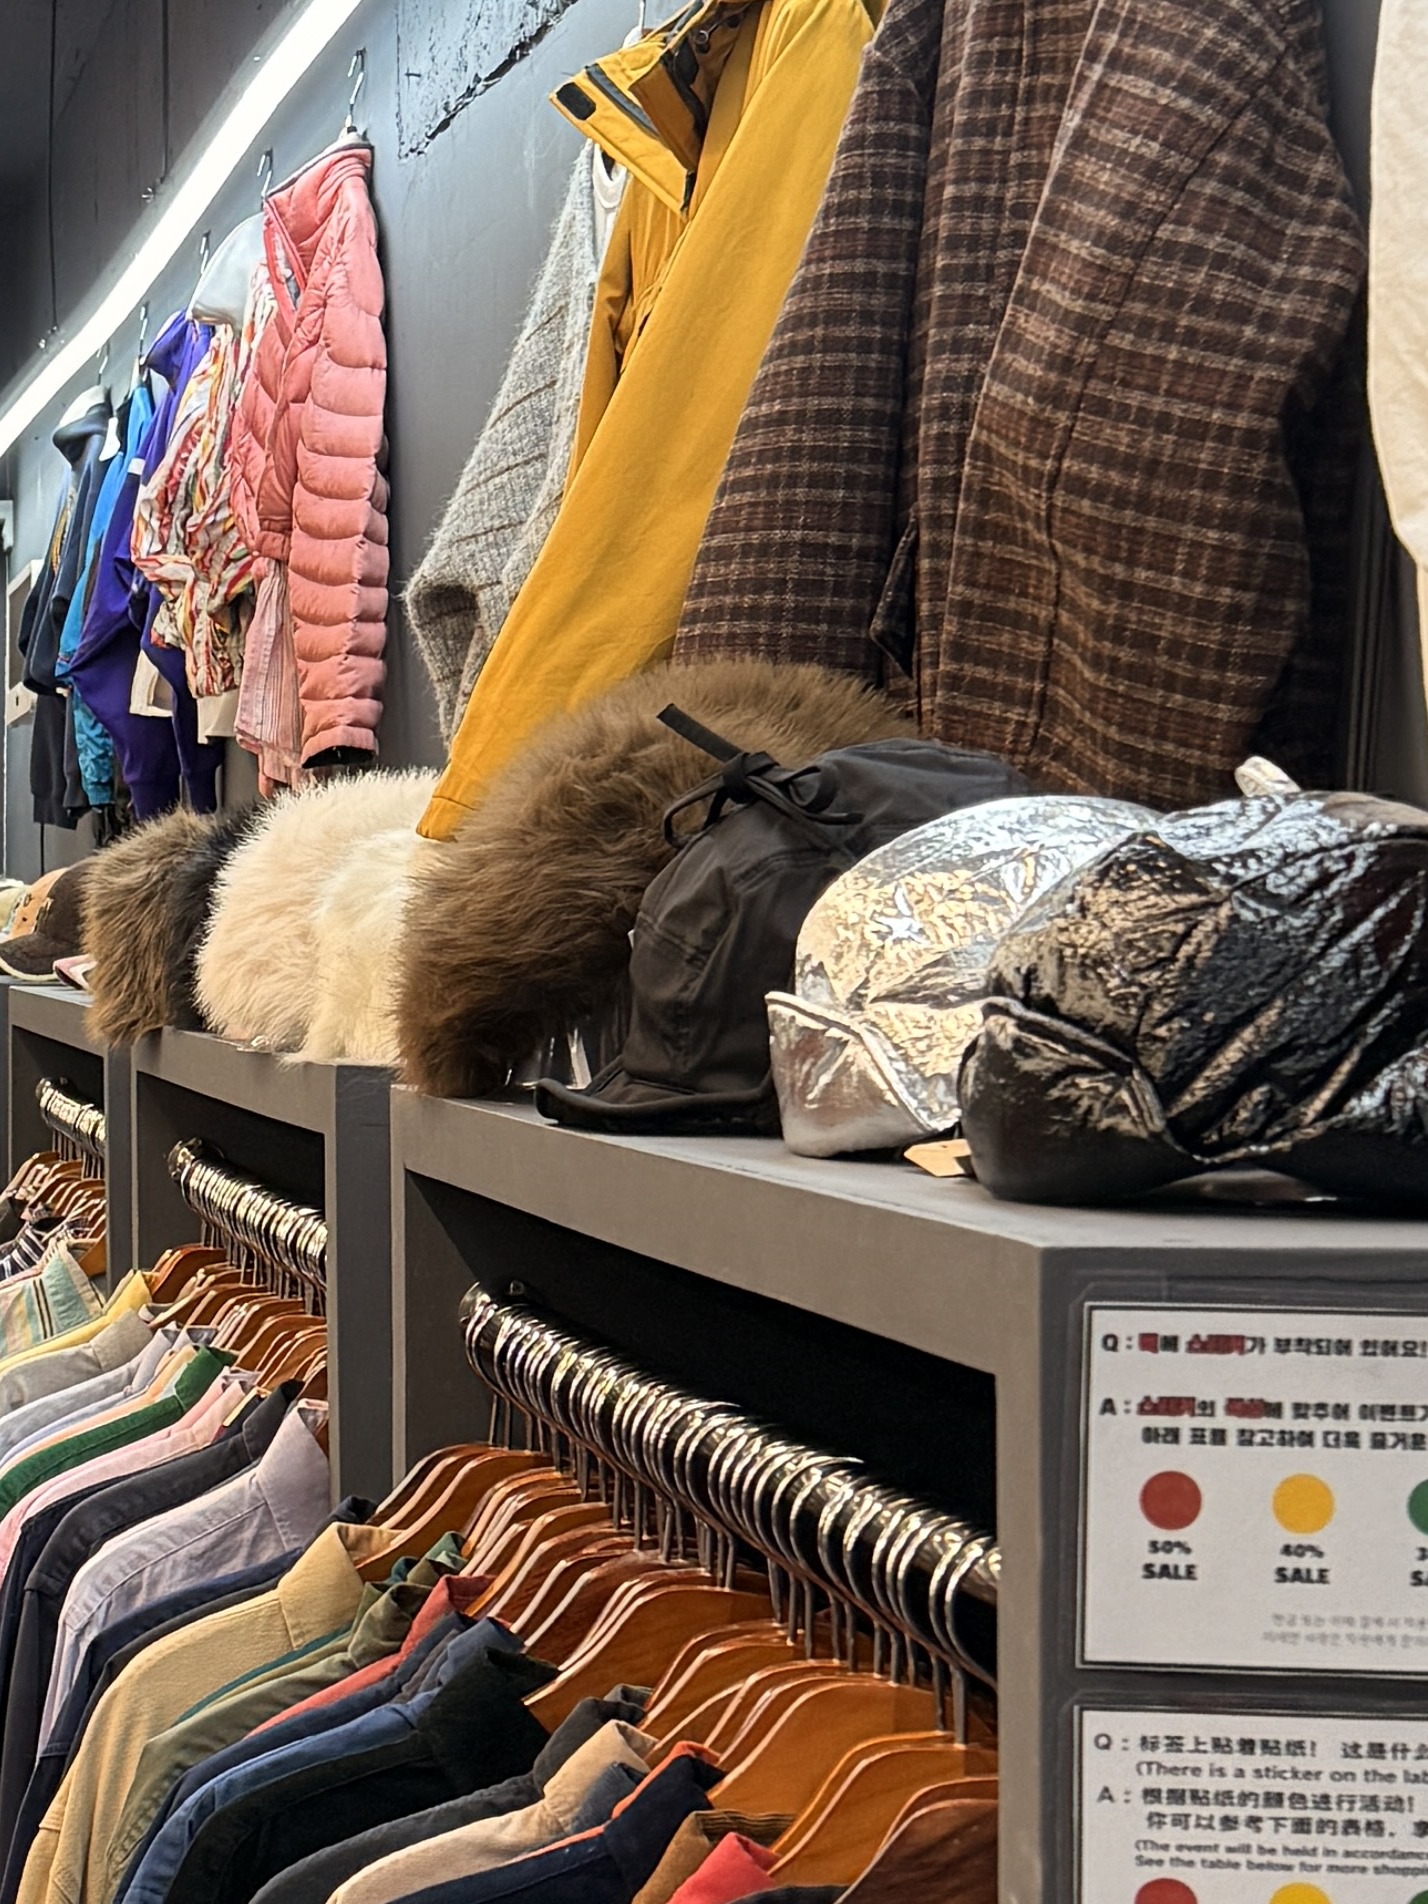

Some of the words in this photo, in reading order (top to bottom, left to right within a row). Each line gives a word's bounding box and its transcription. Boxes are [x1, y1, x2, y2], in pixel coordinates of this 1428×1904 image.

[1101, 1333, 1119, 1352] Q
[1099, 1397, 1117, 1416] A
[1148, 1540, 1192, 1554] 50%
[1142, 1563, 1198, 1581] SALE
[1274, 1566, 1330, 1585] SALE
[1094, 1733, 1113, 1750] Q
[1136, 1760, 1202, 1777] (There
[1209, 1763, 1226, 1778] is
[1234, 1767, 1245, 1778] a
[1252, 1765, 1323, 1781] sticker
[1329, 1770, 1357, 1782] on
[1364, 1769, 1397, 1783] the
[1097, 1785, 1114, 1803] A
[1134, 1855, 1164, 1866] See
[1169, 1856, 1195, 1868] the
